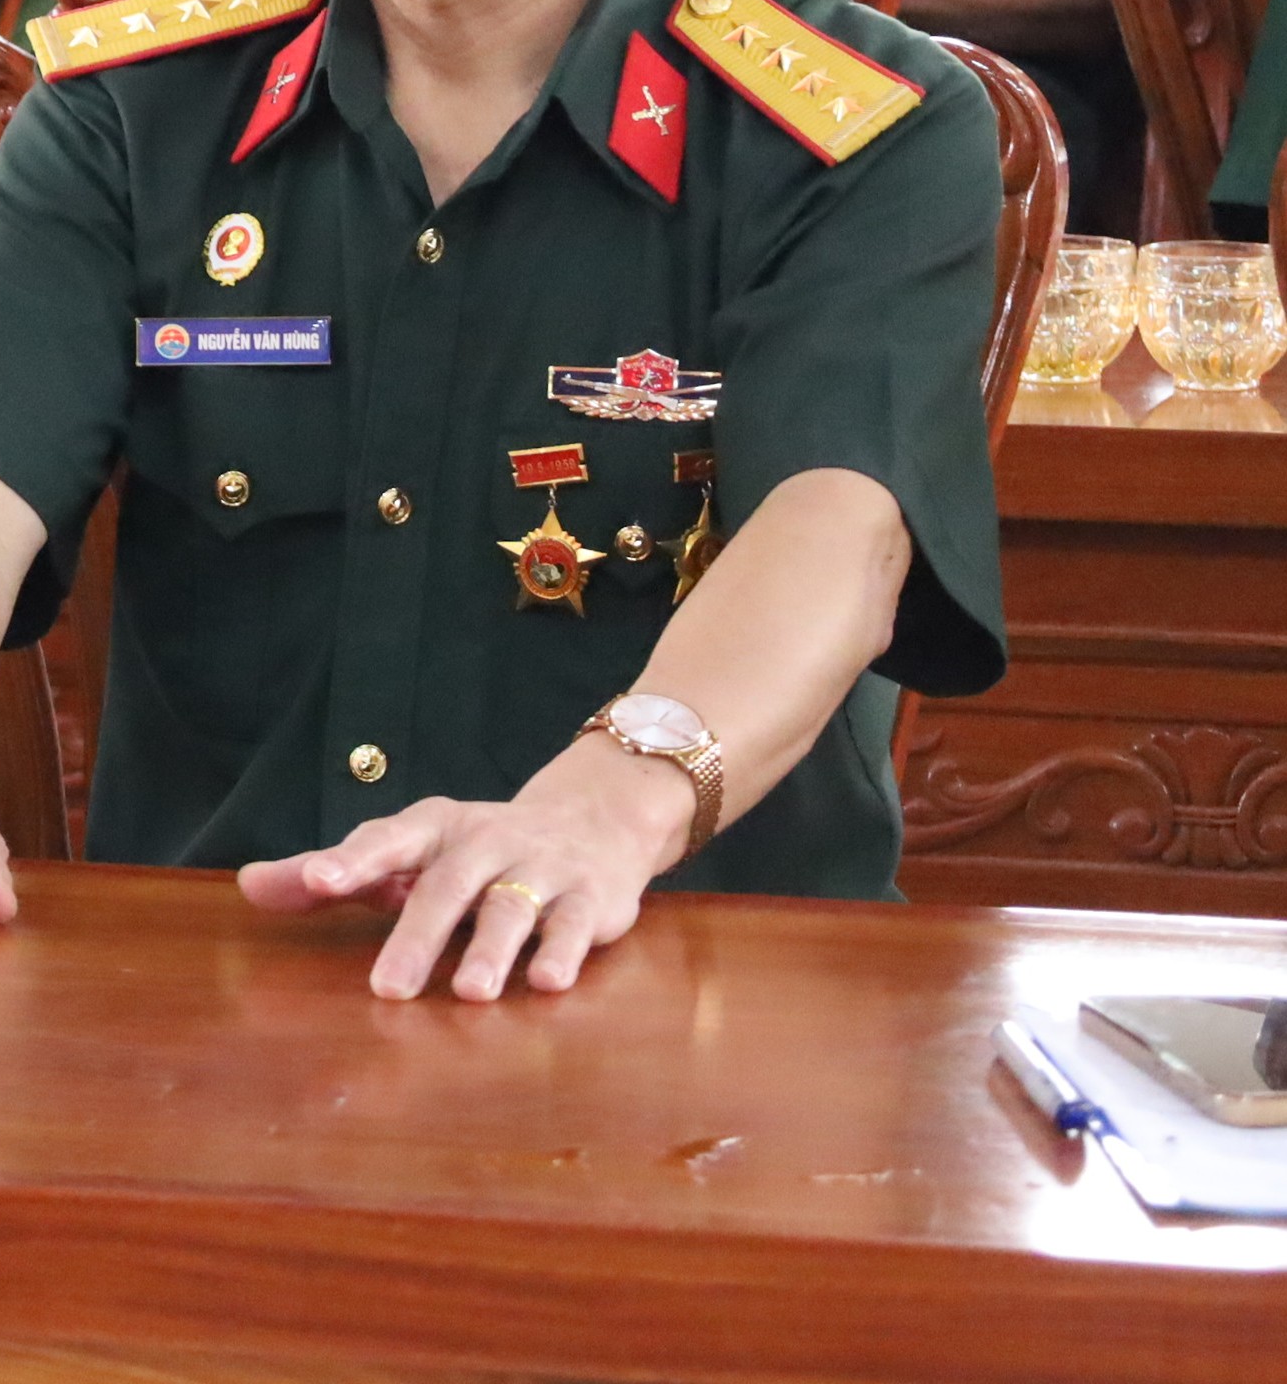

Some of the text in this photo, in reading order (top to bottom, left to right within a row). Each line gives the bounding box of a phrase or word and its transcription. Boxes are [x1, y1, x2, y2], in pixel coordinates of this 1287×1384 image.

[198, 328, 320, 351] NGUYỄN VĂN HÙNG
